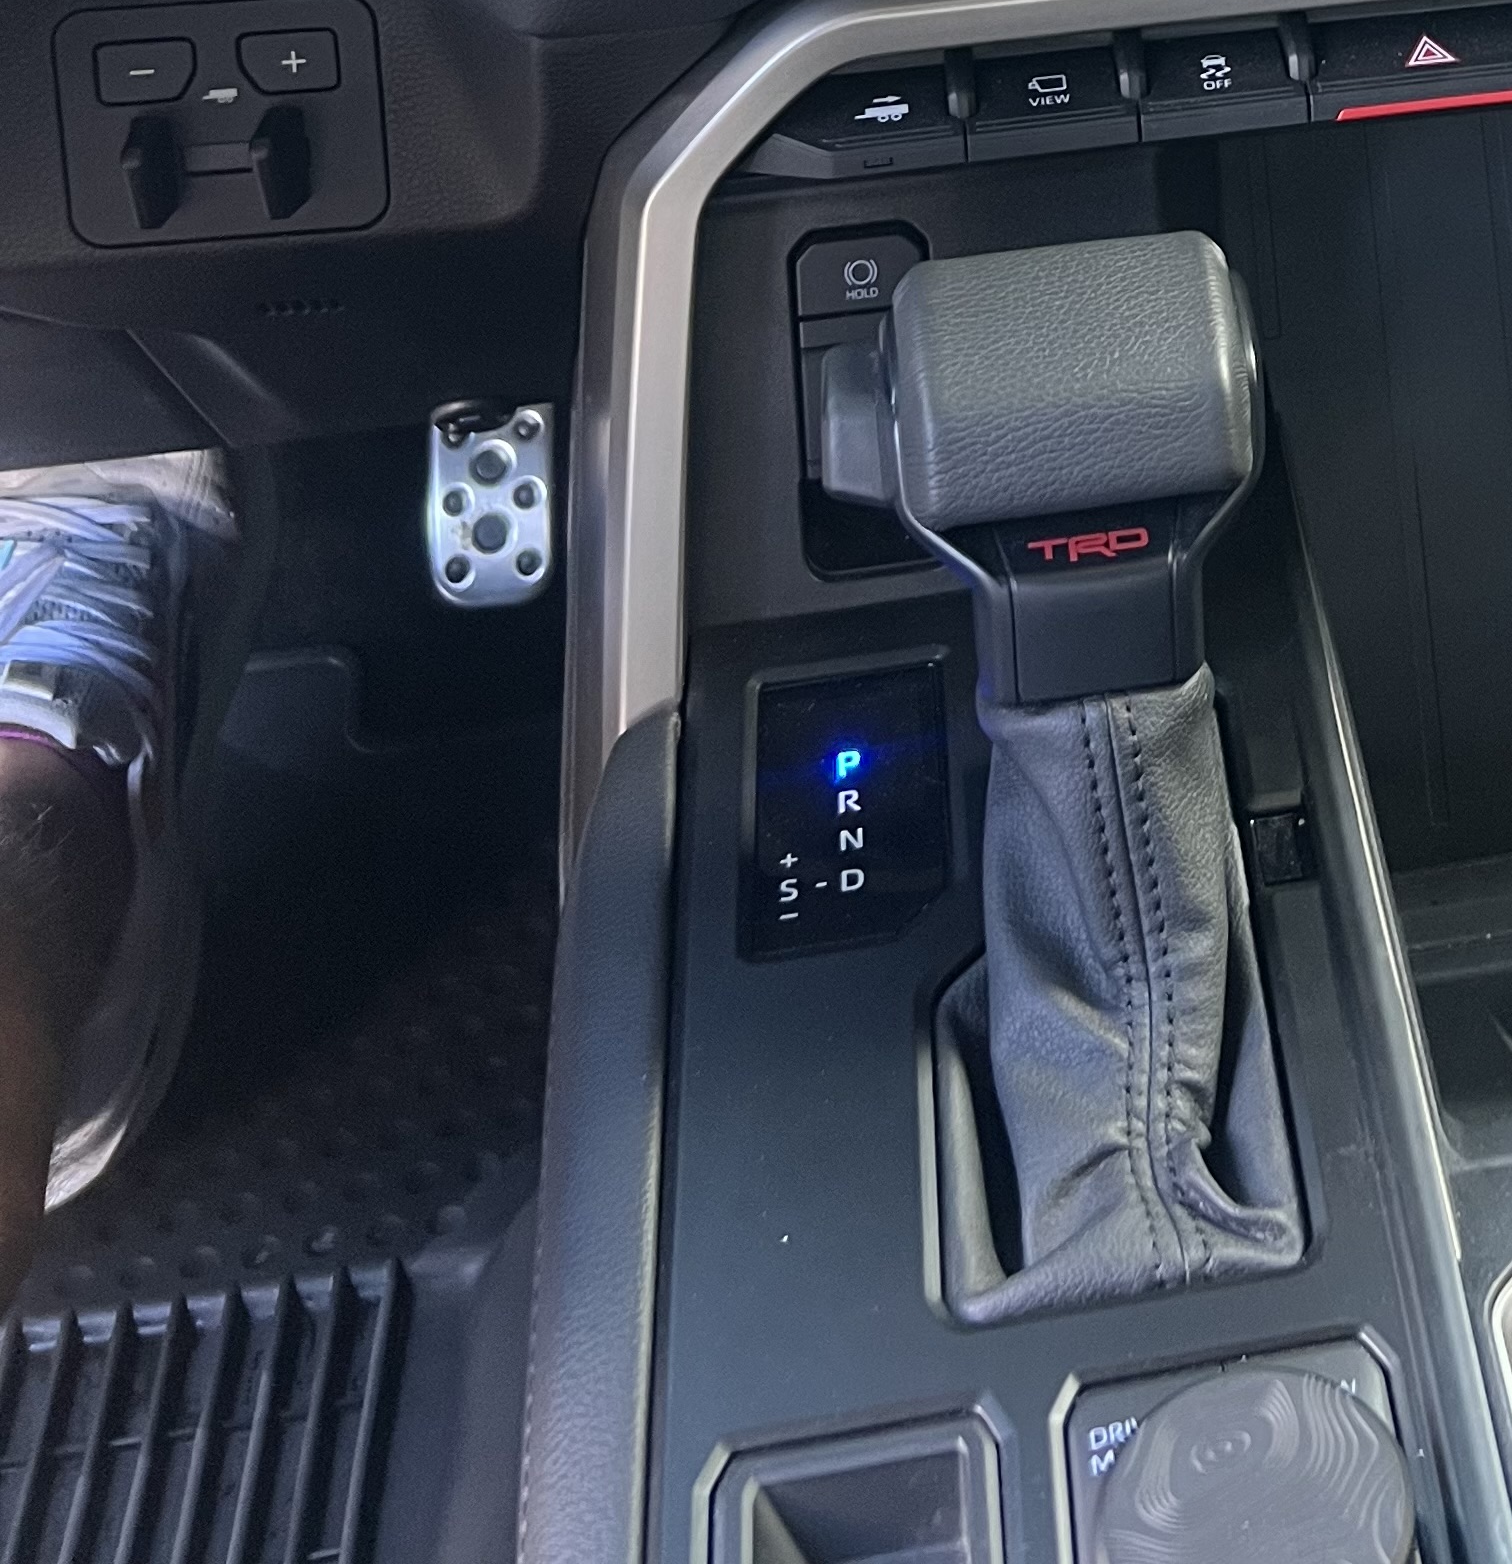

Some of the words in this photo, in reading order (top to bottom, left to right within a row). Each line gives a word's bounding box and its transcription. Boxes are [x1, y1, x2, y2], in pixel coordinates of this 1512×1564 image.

[1203, 78, 1233, 91] OFF
[1028, 93, 1071, 107] VIEW
[846, 287, 879, 300] HOLD
[1027, 527, 1150, 562] TRD
[836, 751, 861, 780] P
[837, 790, 861, 815] R
[840, 828, 864, 851] N
[779, 879, 798, 902] S
[840, 869, 864, 892] D
